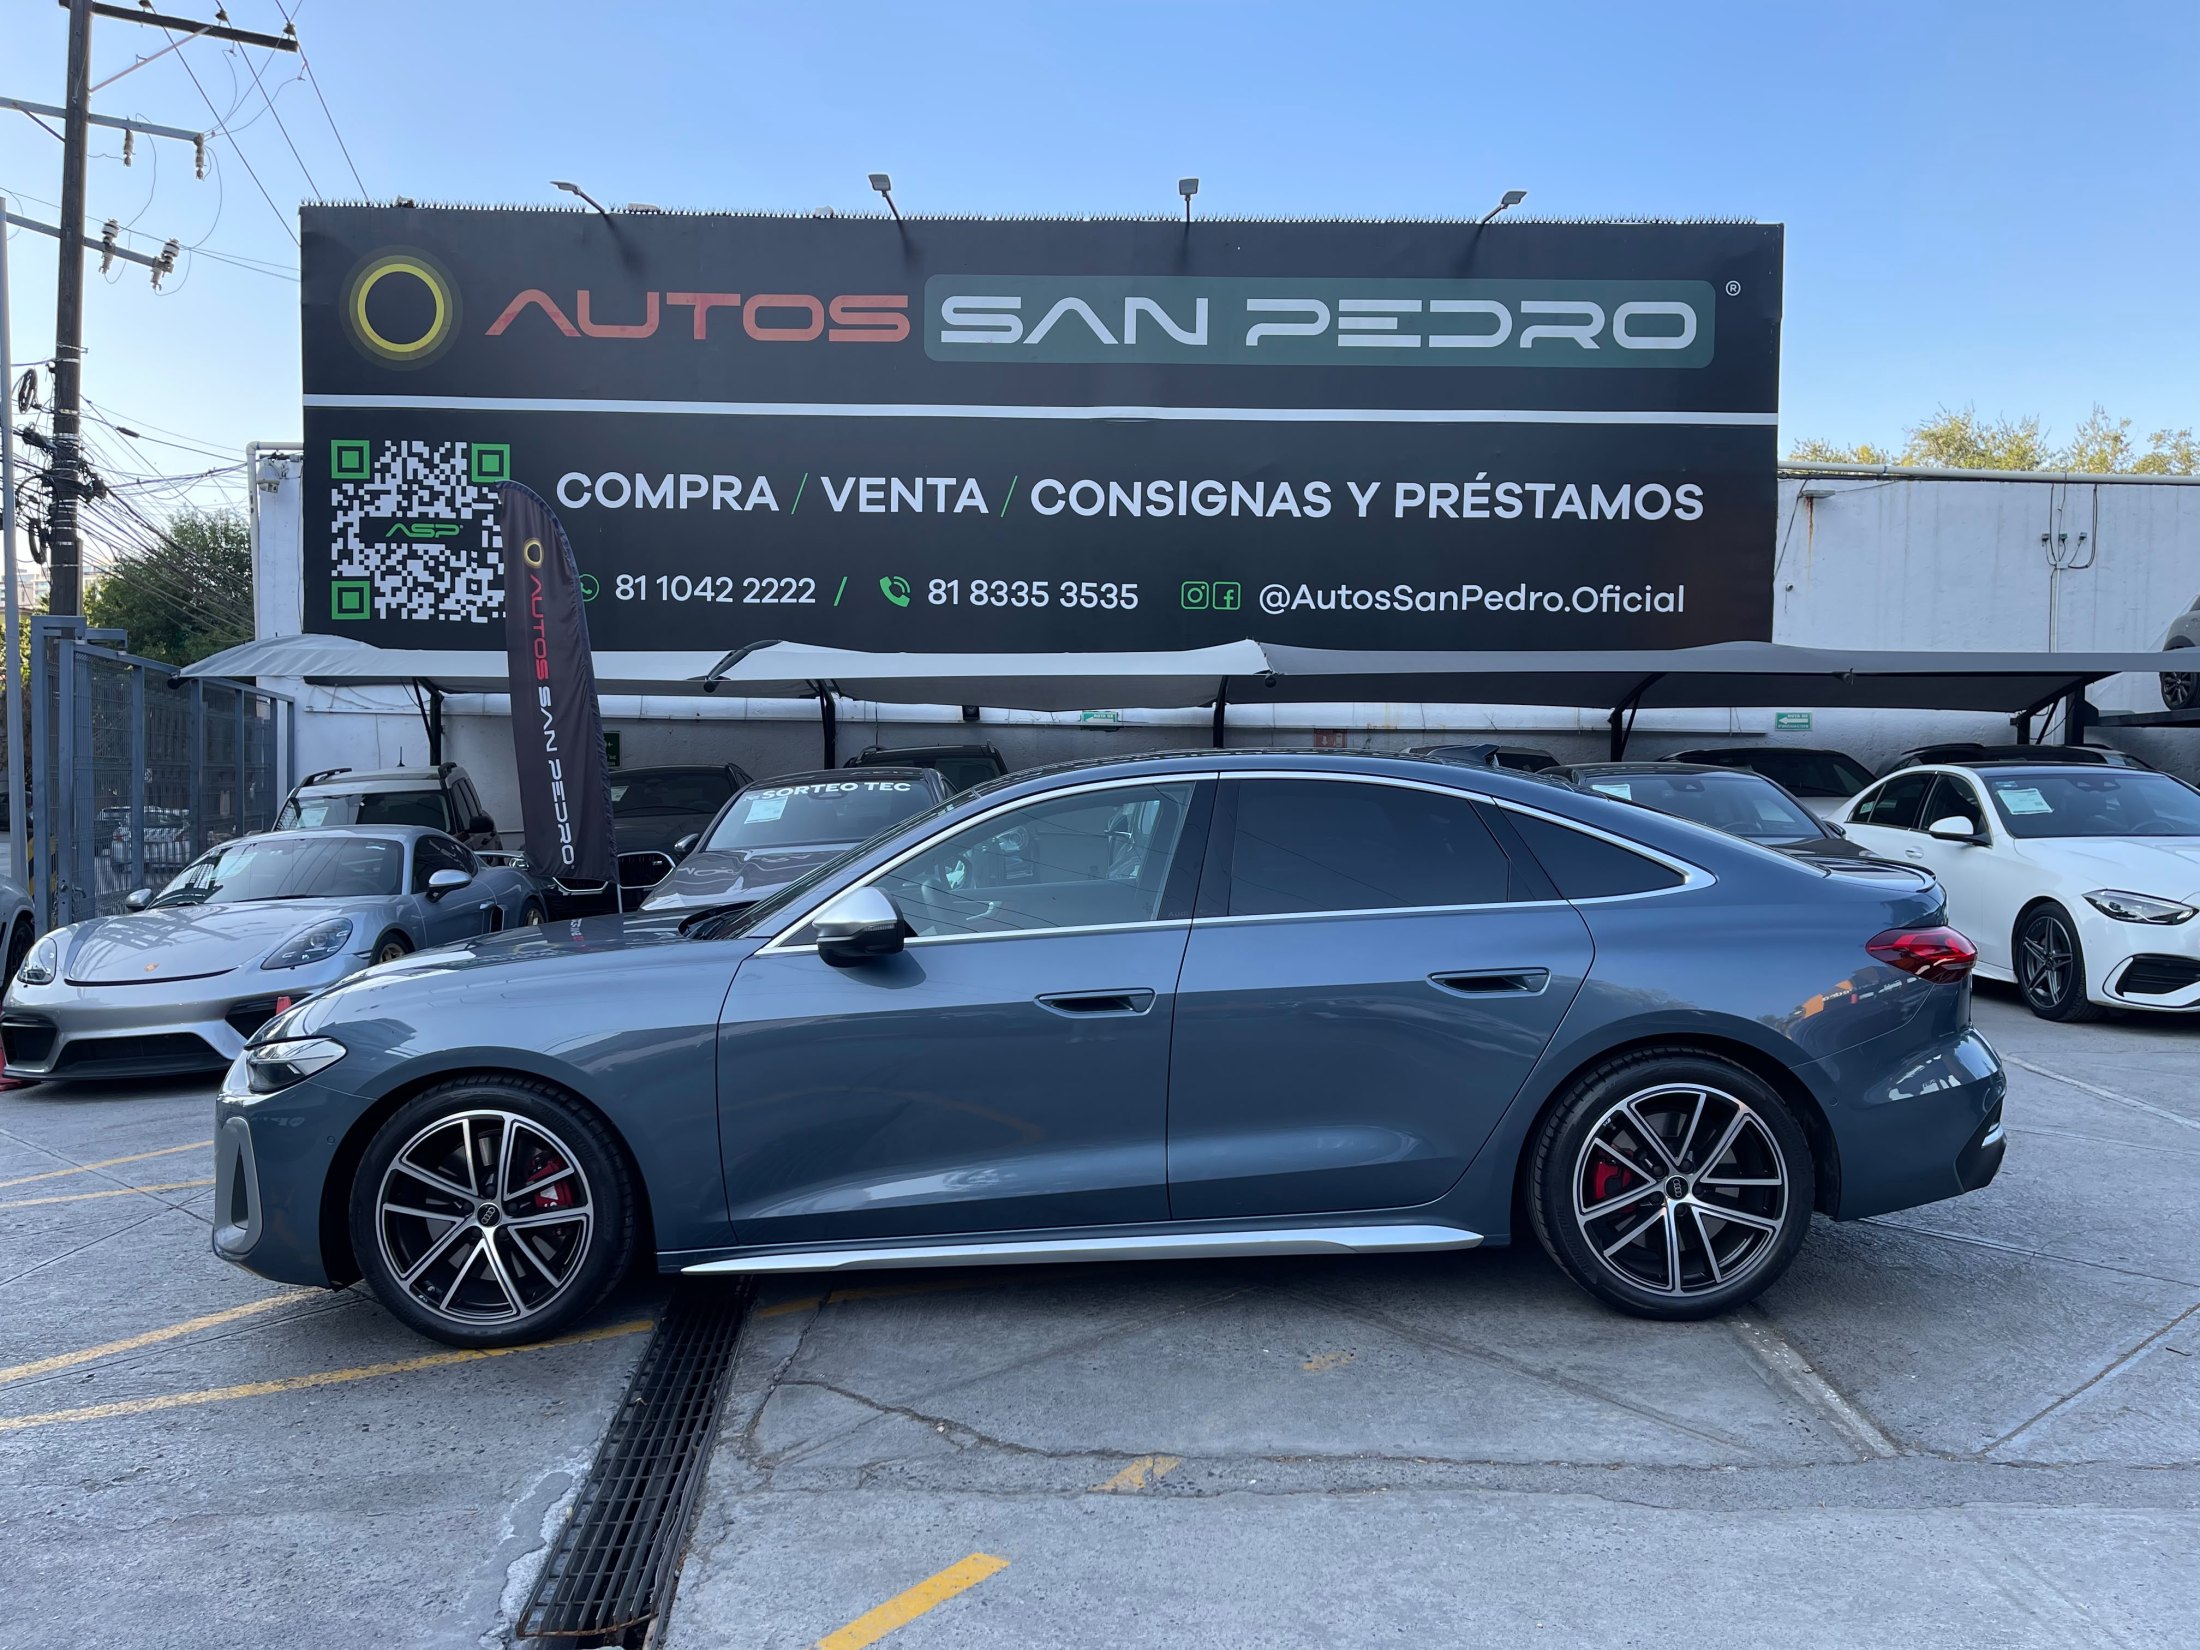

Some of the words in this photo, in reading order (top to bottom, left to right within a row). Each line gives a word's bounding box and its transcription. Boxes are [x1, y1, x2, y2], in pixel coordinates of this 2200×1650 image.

[485, 288, 911, 343] AUTOS
[940, 295, 1209, 346] SAN
[1245, 298, 1697, 350] PEDRO
[556, 471, 780, 512] COMPRA
[820, 476, 990, 514] VENTA
[1030, 478, 1332, 518] CONSIGNAS
[1346, 481, 1381, 518] Y
[1394, 471, 1704, 521] PRÉSTAMOS
[385, 522, 460, 538] ASP
[615, 573, 646, 601] 81
[656, 574, 734, 603] 1042
[742, 577, 816, 604] 2222
[927, 578, 959, 605] 81
[969, 579, 1050, 608] 8335
[1059, 581, 1139, 610] 3535
[1259, 583, 1685, 615] @AutosSanPedro.Oficial
[530, 574, 549, 680] AUTOS
[538, 686, 557, 752] SAN
[548, 758, 575, 865] PEDRO
[762, 782, 859, 800] SORTEO
[863, 782, 912, 792] TEC
